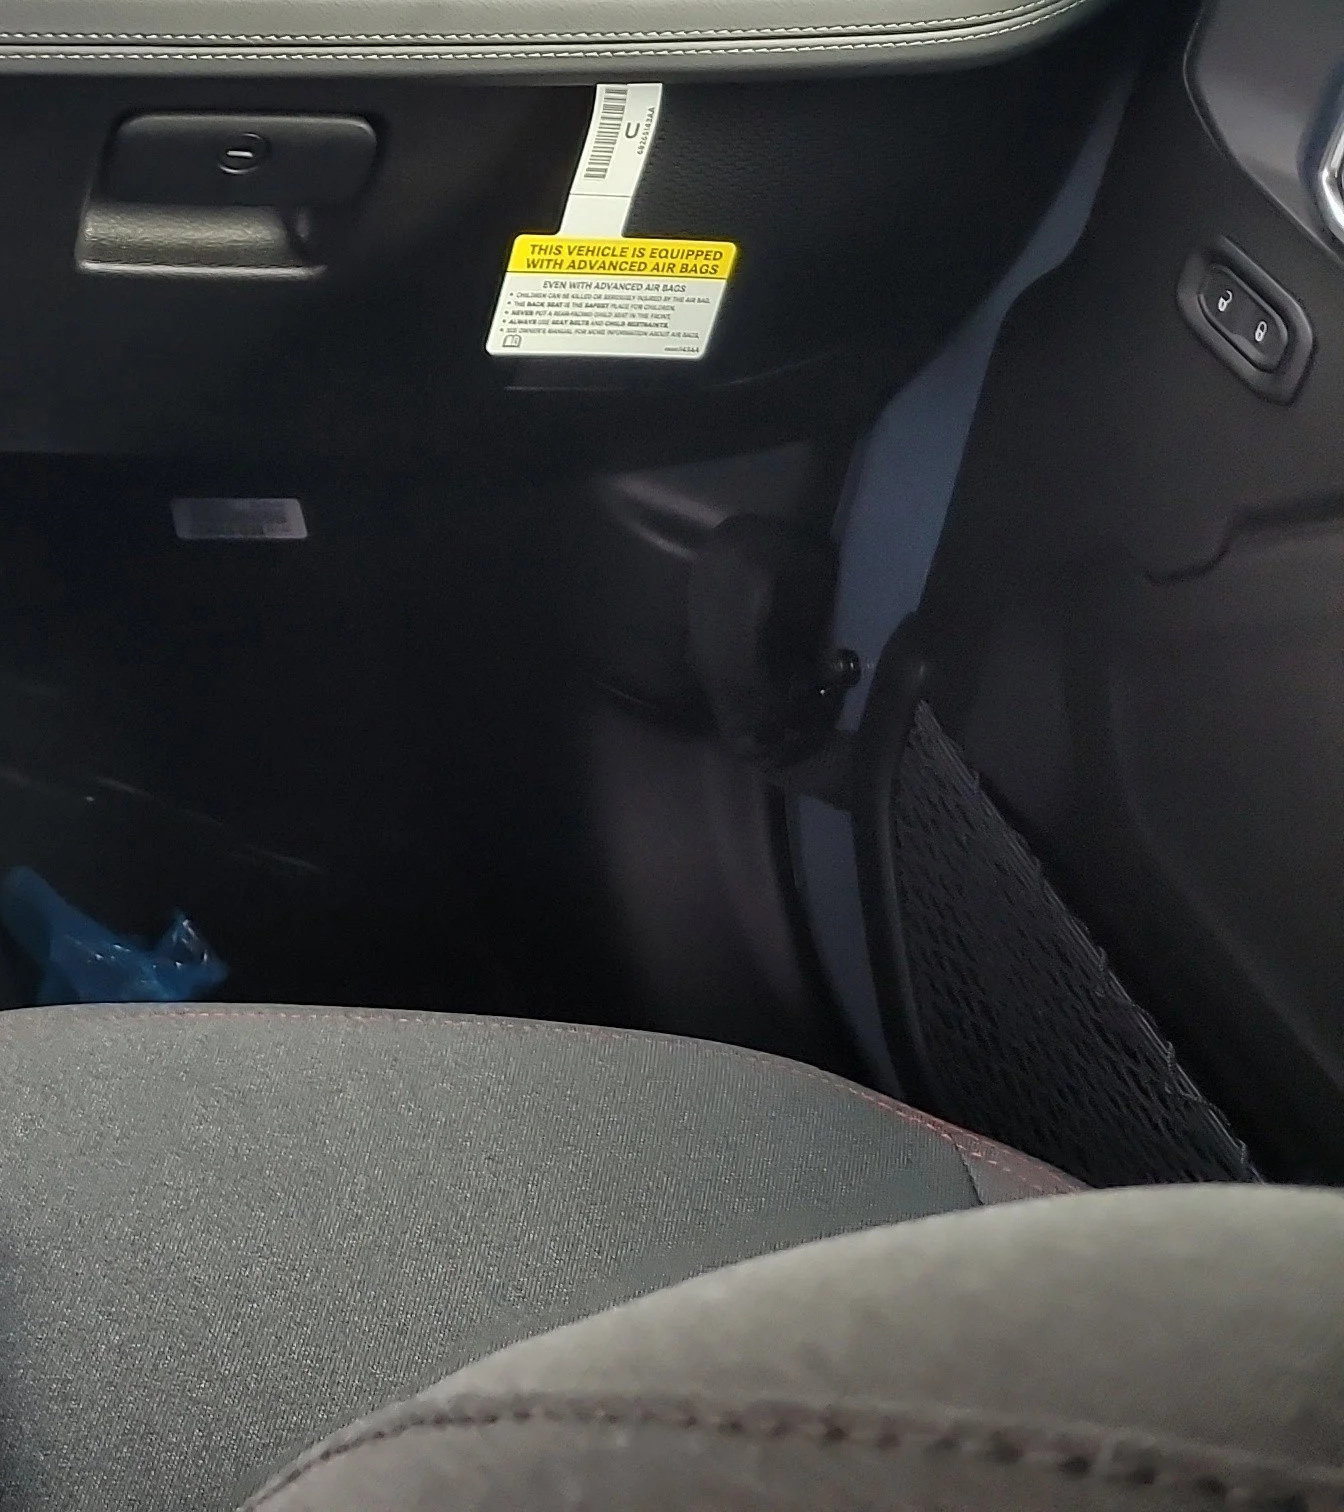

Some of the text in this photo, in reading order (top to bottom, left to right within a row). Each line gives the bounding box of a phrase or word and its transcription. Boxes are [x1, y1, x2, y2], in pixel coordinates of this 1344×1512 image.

[530, 244, 723, 261] THIS VEHICLE IS EQUIPPED
[526, 258, 719, 275] WITH ADVANCED AIR BAGS
[543, 281, 686, 293] EVEN WITH ADVANCED AIR BAGS
